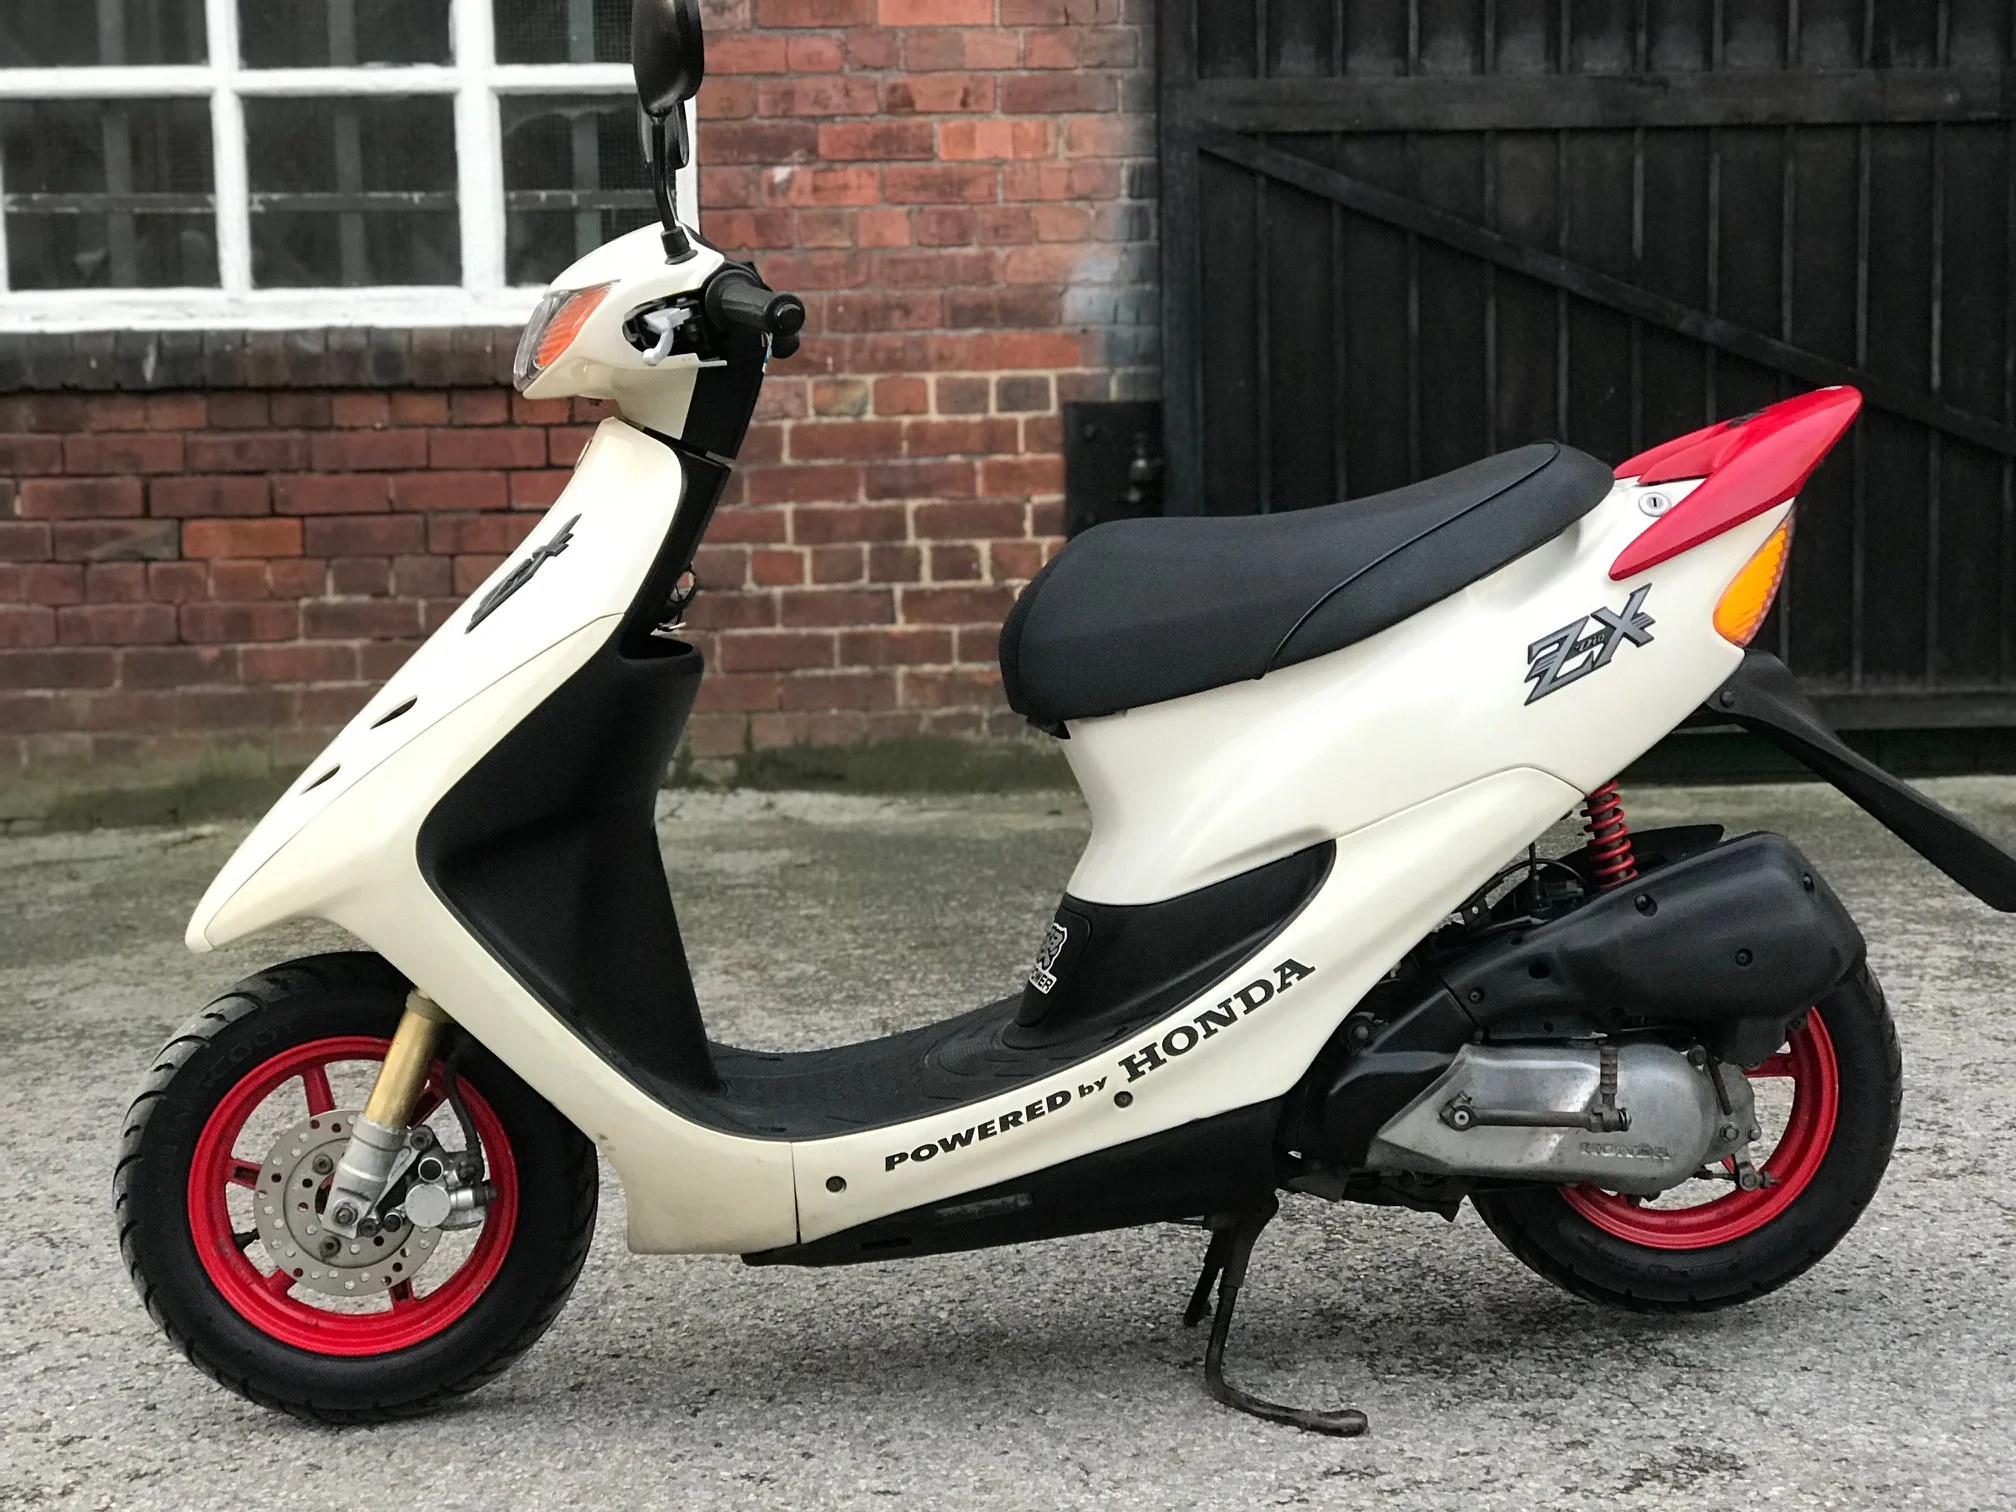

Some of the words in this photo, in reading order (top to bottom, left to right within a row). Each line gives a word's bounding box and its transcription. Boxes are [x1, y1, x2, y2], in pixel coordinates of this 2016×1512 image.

[1523, 582, 1656, 706] ZX
[1575, 633, 1605, 652] Dio
[884, 1090, 1072, 1172] POWERED
[1078, 1076, 1109, 1098] by
[1117, 958, 1317, 1083] HONDA
[1580, 1142, 1671, 1160] HONDA
